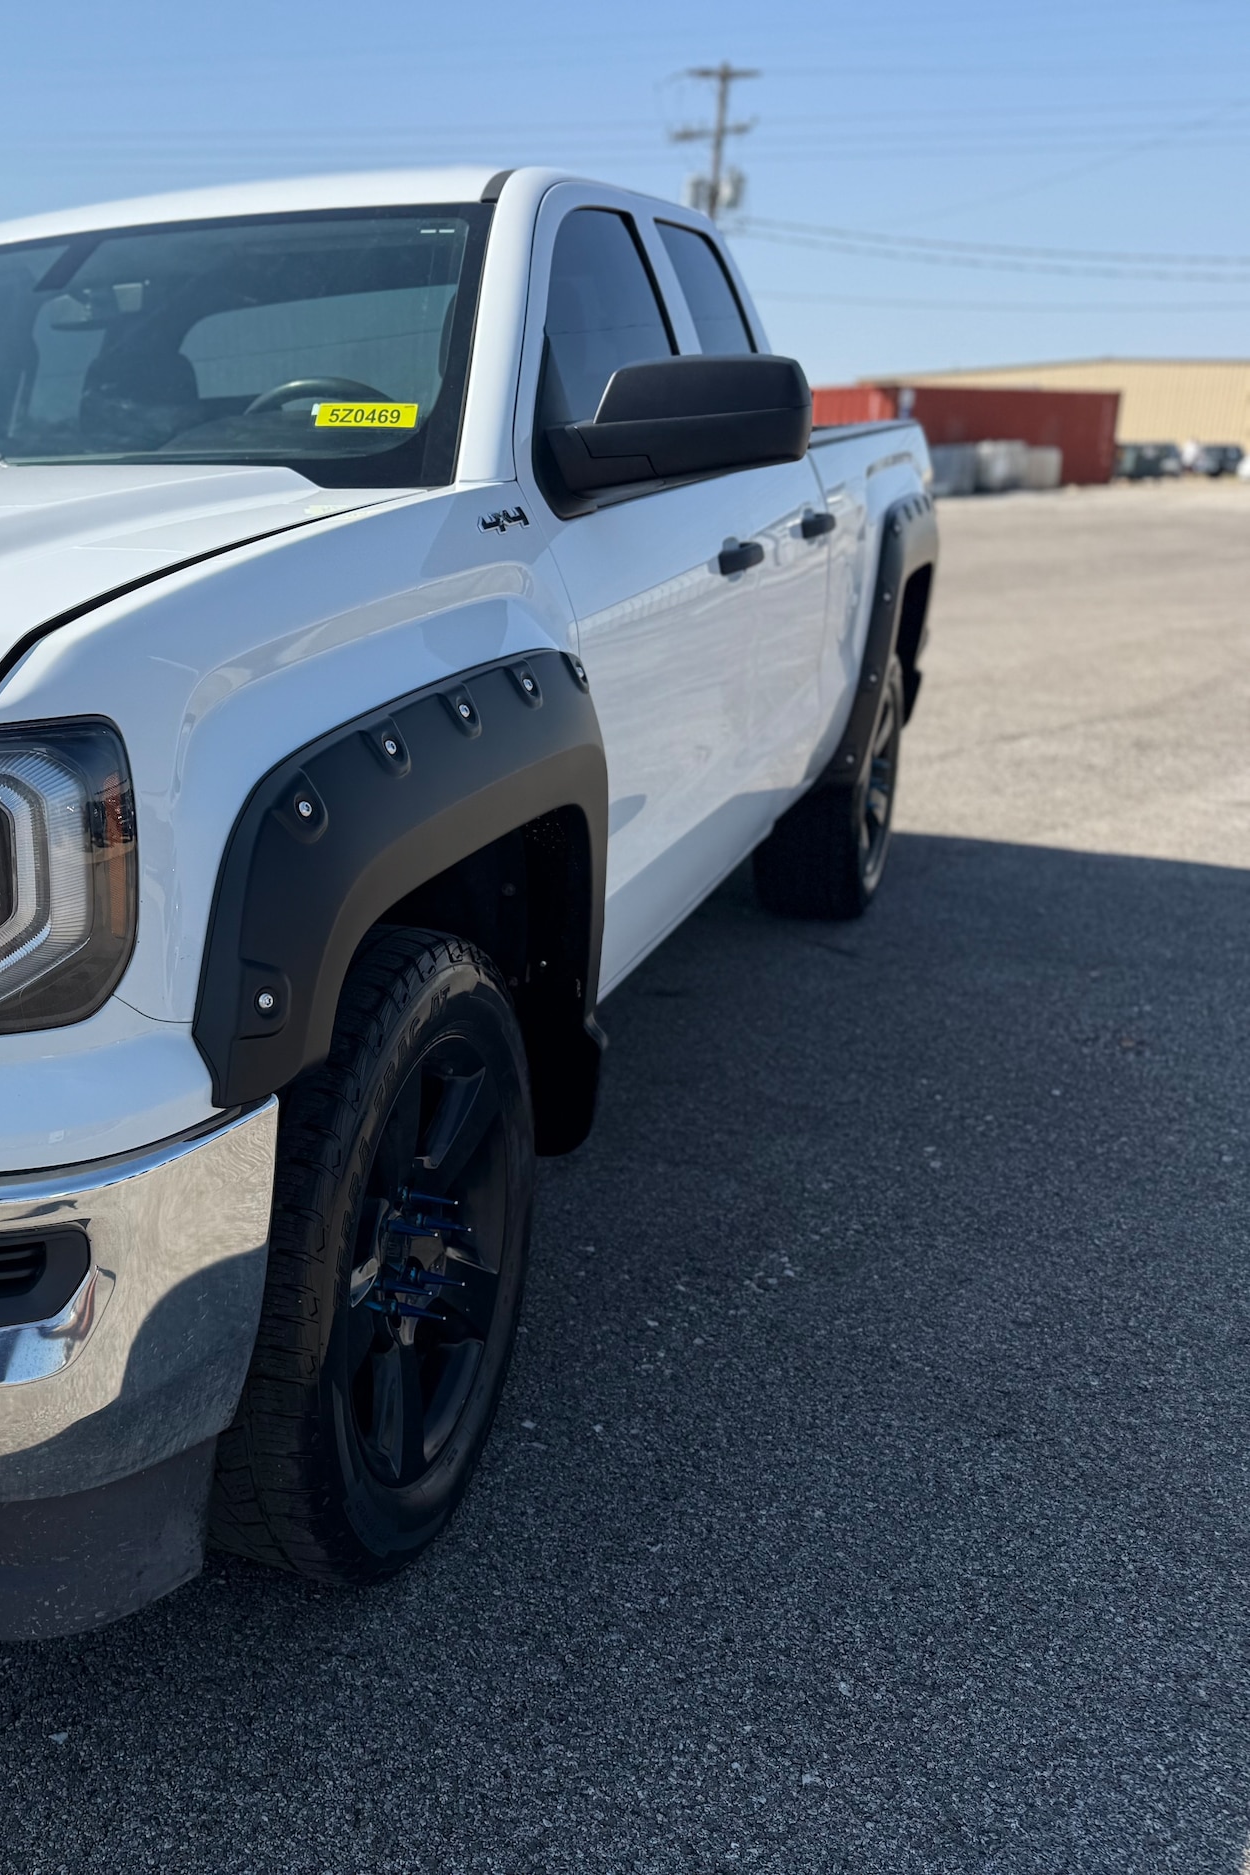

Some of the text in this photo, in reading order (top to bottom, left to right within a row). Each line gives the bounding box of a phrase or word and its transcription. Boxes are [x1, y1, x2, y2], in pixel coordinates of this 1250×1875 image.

[328, 408, 401, 424] 5Z0469
[334, 1136, 371, 1308] TERRA
[374, 1016, 421, 1114] TRAC
